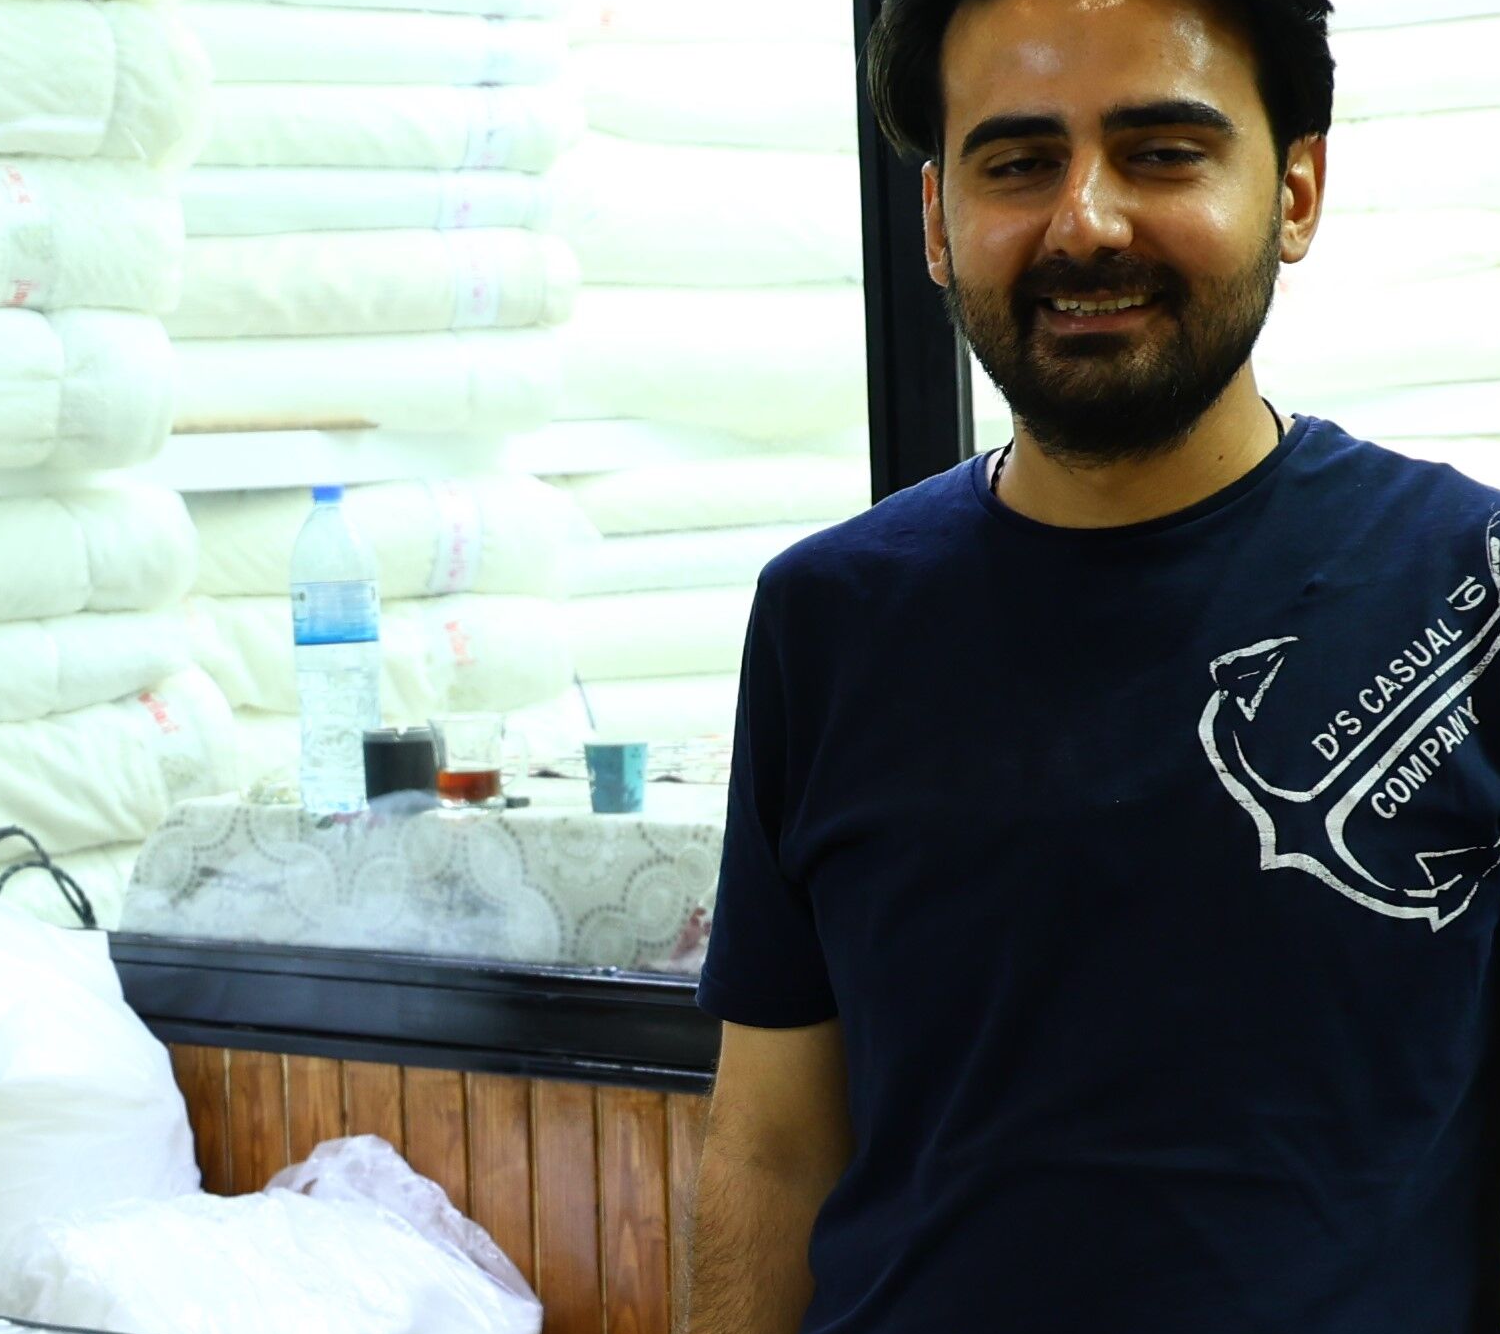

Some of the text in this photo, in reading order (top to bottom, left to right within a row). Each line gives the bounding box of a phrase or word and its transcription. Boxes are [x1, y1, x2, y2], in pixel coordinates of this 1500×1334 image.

[1446, 575, 1488, 611] 19
[1311, 618, 1463, 762] D'S CASUAL
[1370, 696, 1481, 819] COMPANY
